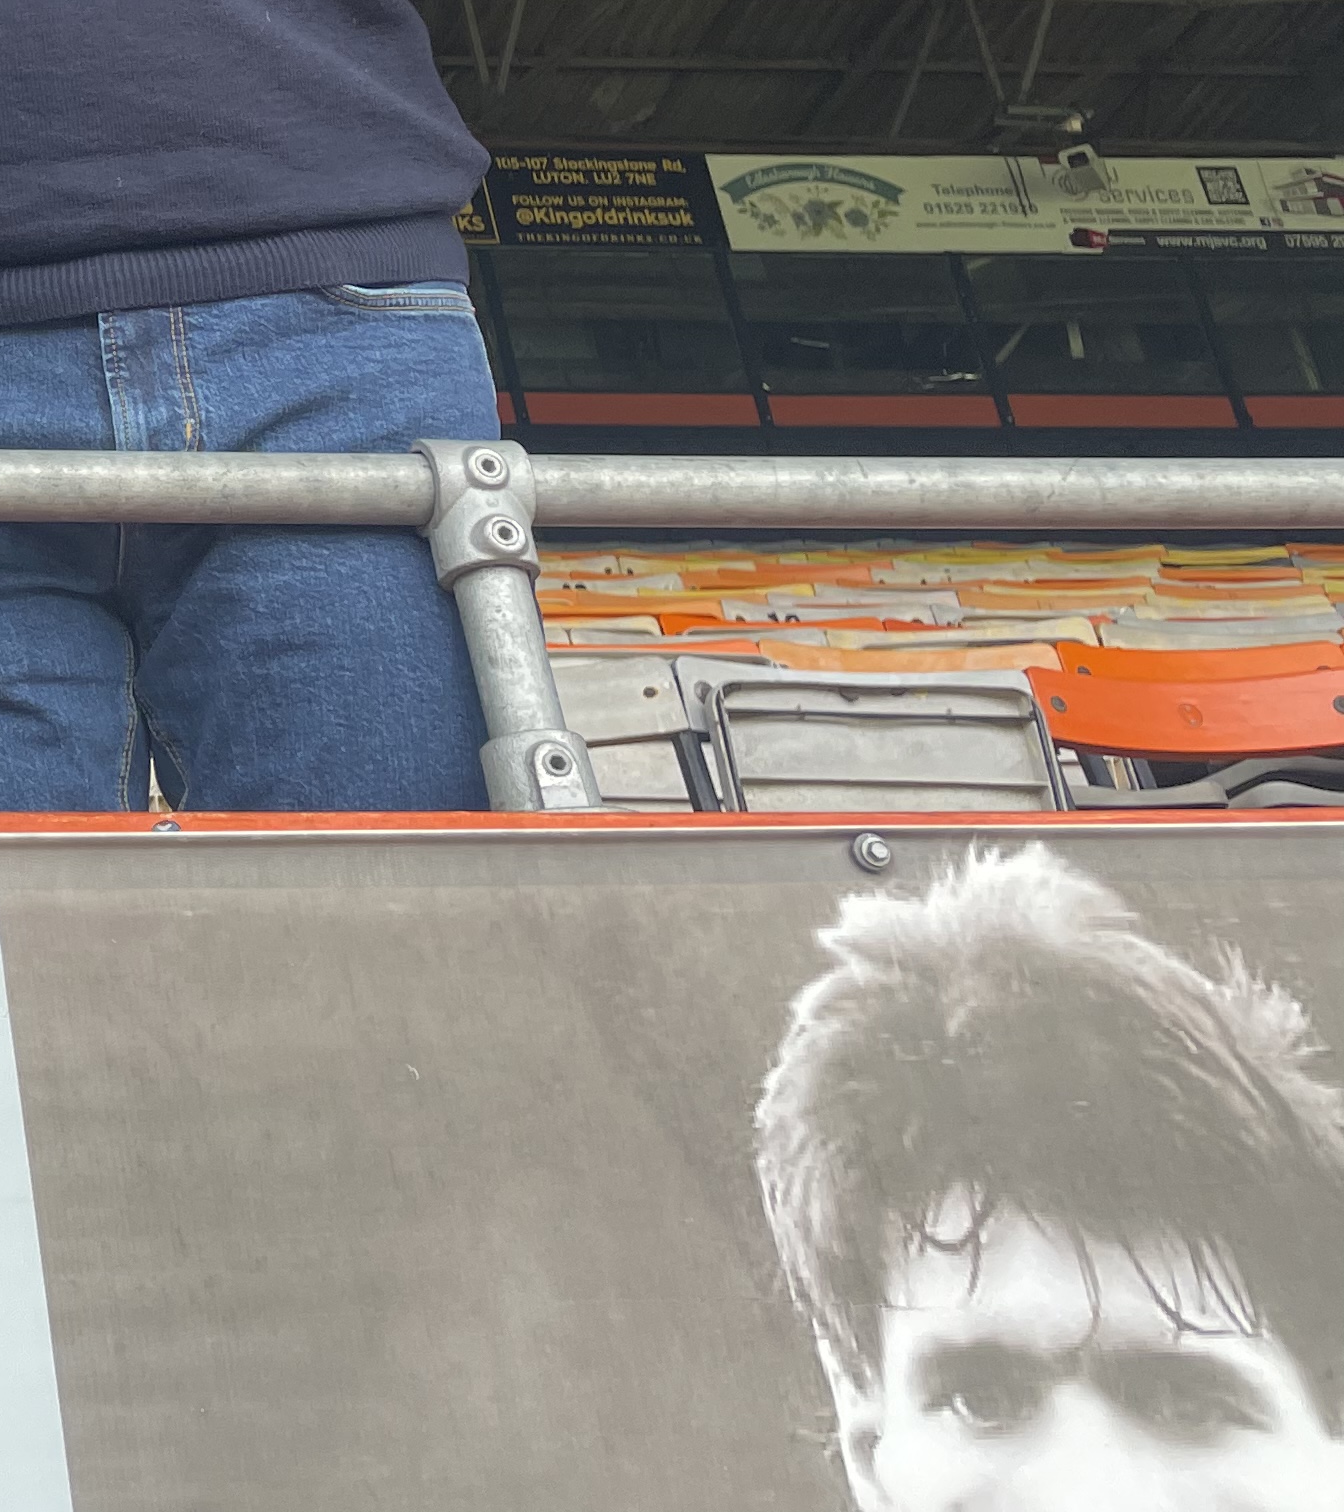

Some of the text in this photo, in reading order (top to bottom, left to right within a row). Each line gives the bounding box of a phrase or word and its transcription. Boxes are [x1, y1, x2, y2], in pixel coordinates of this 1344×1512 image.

[931, 183, 1014, 198] Telephone
[512, 194, 563, 206] FOLLOW
[568, 195, 585, 206] US
[588, 195, 608, 207] ON
